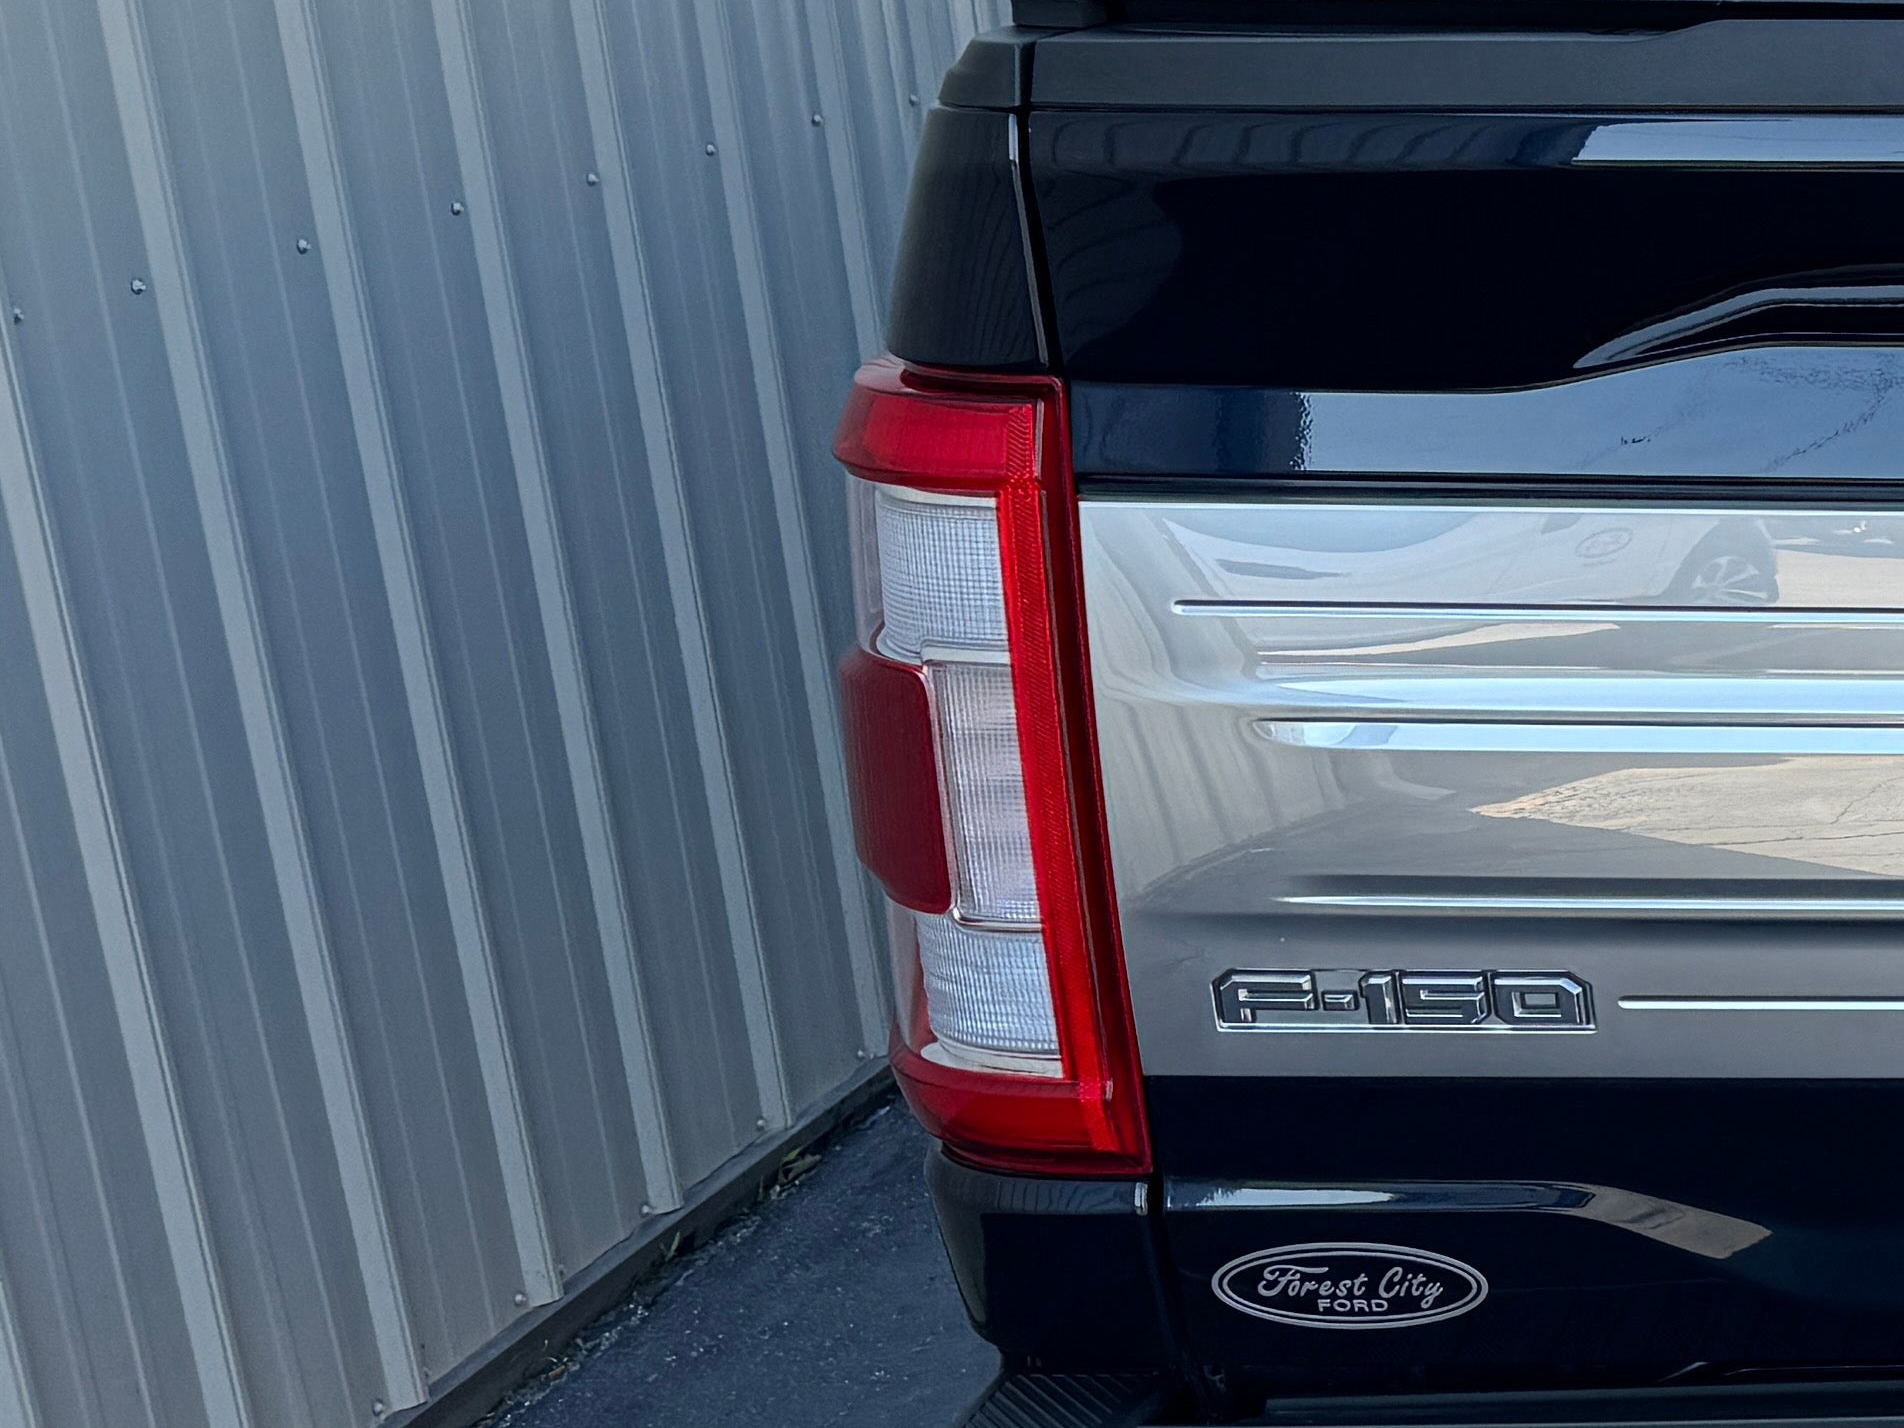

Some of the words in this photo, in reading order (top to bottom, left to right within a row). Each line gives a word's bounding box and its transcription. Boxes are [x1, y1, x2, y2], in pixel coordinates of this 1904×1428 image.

[1211, 968, 1598, 1034] F-150
[1257, 1264, 1367, 1298] Forest
[1378, 1266, 1444, 1309] City
[1318, 1298, 1389, 1313] FORD
